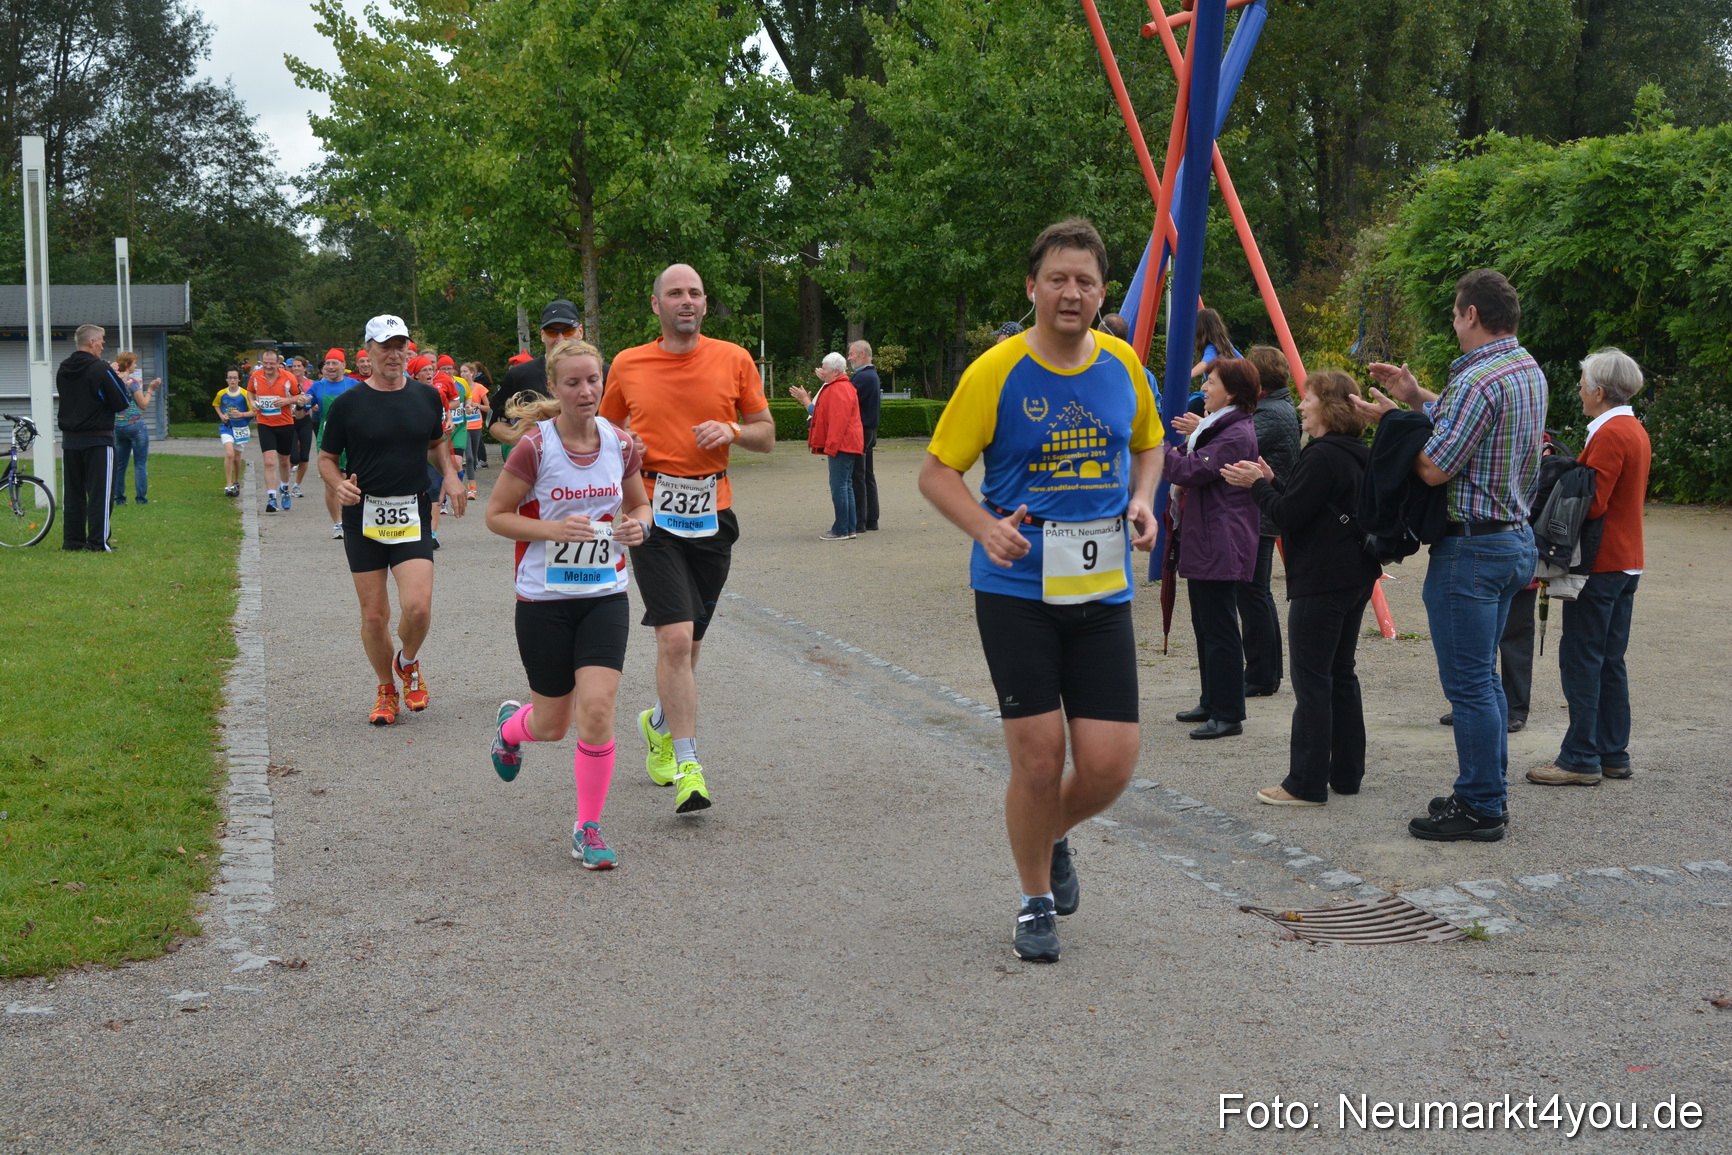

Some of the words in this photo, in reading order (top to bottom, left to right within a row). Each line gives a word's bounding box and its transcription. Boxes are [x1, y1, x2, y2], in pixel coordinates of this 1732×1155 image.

[657, 480, 679, 489] PARTL
[1028, 482, 1119, 492] www.stadtlauf-neumarkt.de
[551, 482, 619, 500] Oberbank
[660, 490, 711, 514] 2322
[375, 507, 410, 526] 335
[667, 518, 704, 530] Christian
[378, 529, 406, 537] Werner
[1045, 528, 1076, 537] PARTL
[1078, 525, 1114, 537] Neumarkt
[554, 539, 610, 565] 2773
[1082, 540, 1098, 570] 9
[564, 570, 601, 582] Melanie
